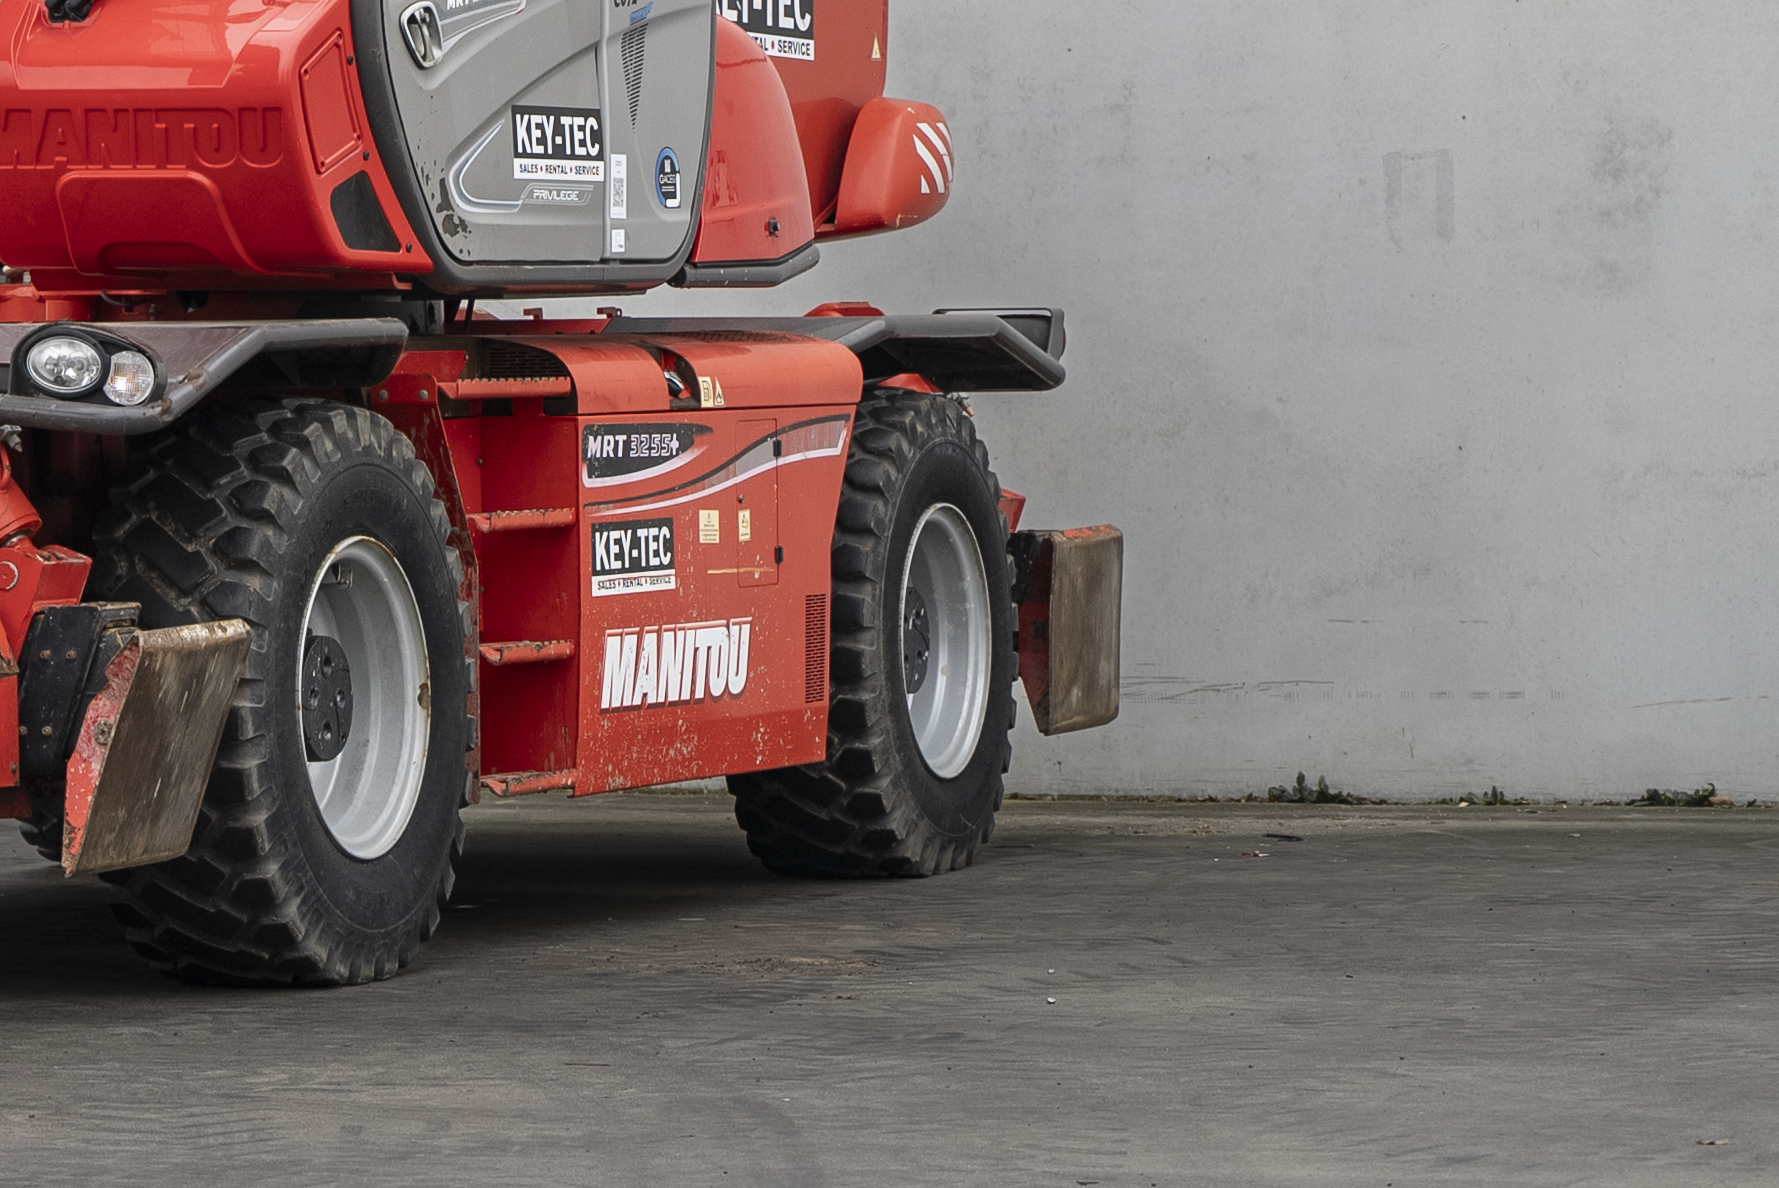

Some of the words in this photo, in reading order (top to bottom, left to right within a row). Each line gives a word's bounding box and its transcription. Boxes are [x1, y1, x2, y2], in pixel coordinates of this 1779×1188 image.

[777, 38, 810, 56] SERVICE
[516, 114, 600, 156] KEY-TEC
[519, 163, 538, 173] SALES
[545, 164, 568, 175] RENTAL
[574, 165, 600, 176] SERVICE
[587, 434, 627, 458] MRT
[595, 526, 671, 570] KEY-TEC
[600, 618, 752, 711] MANITOU
